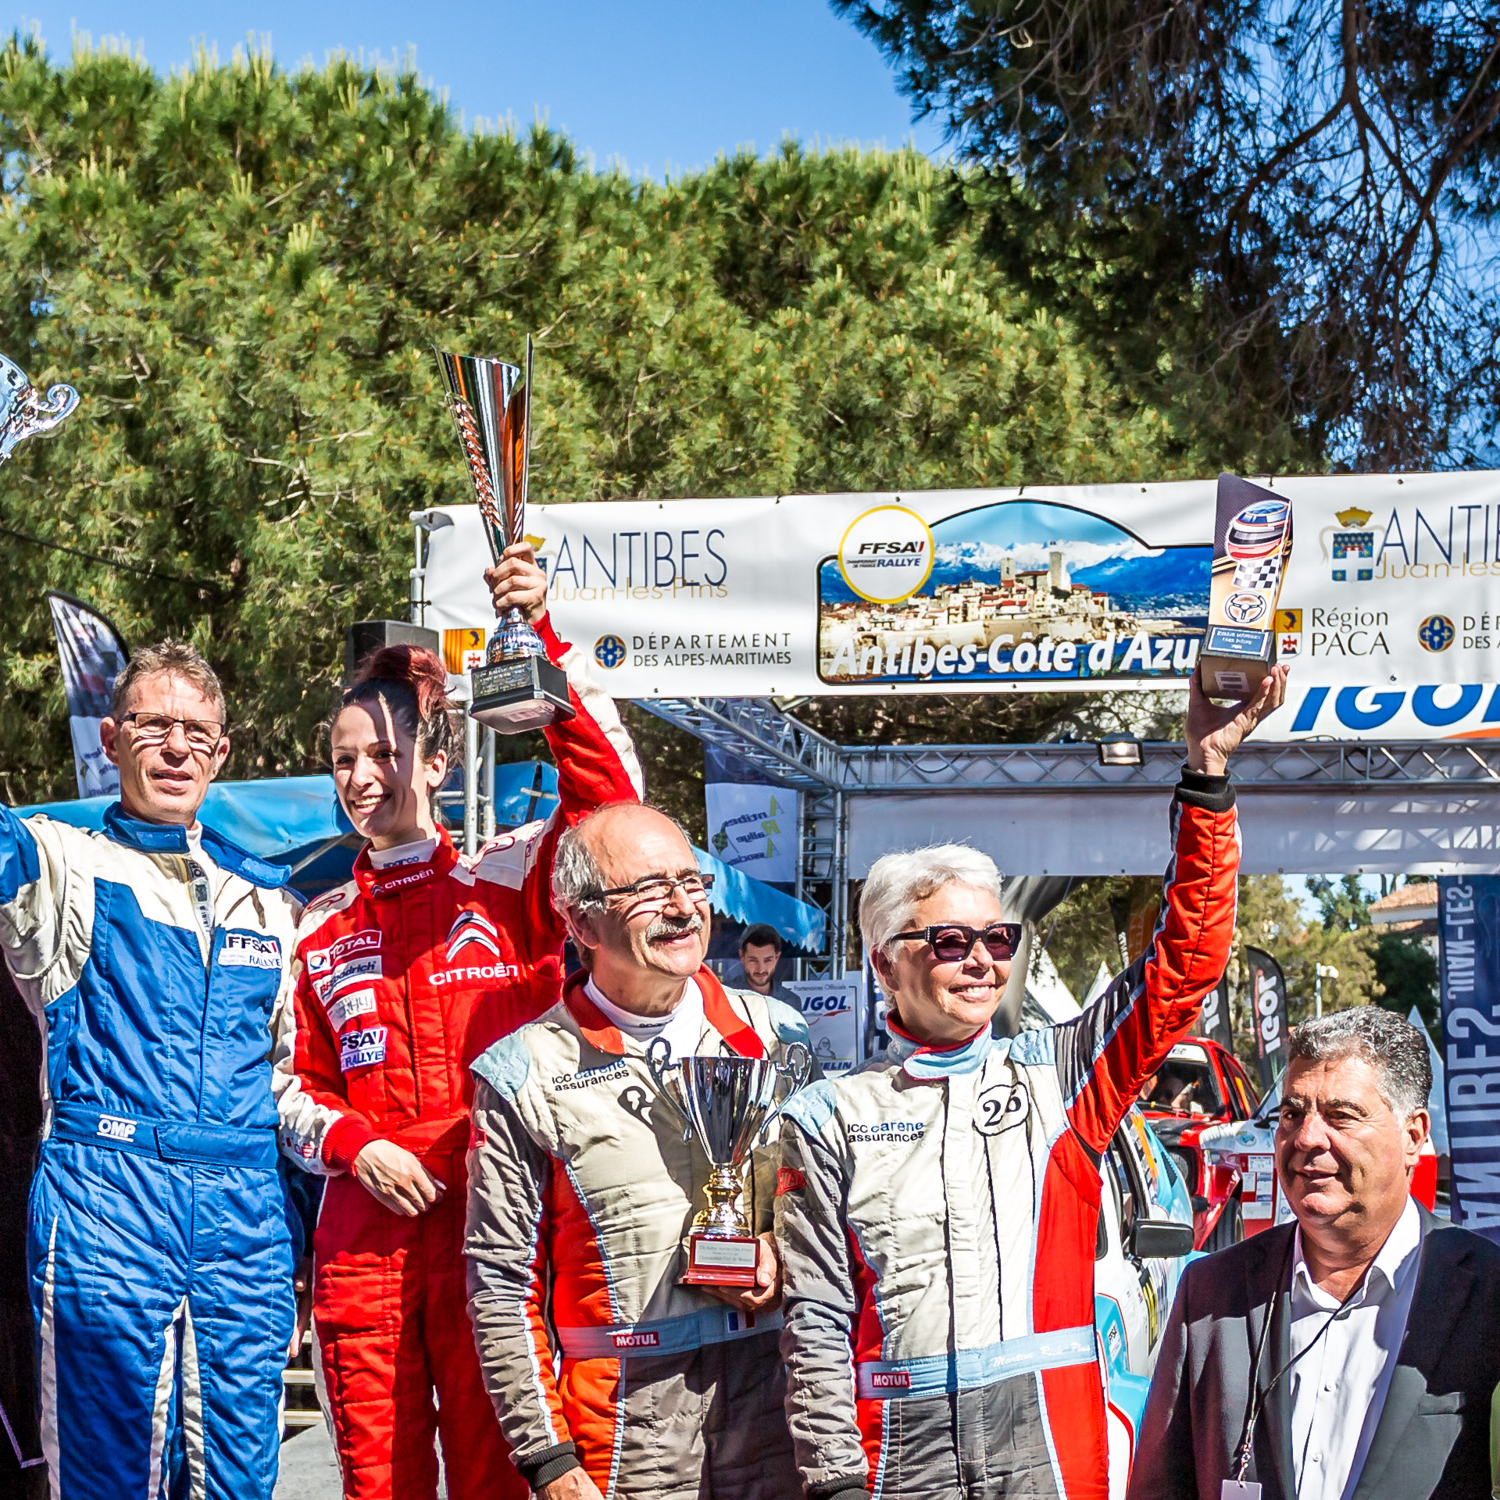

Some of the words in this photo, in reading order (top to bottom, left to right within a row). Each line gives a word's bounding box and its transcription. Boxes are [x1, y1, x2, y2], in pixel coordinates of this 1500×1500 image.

[858, 541, 917, 554] FFSA
[550, 528, 727, 589] ANTIBES
[877, 558, 921, 567] RALLYE
[549, 576, 728, 601] Juan-les-Pins
[1312, 607, 1389, 633] Région
[633, 631, 792, 650] DÉPARTEMENT
[1312, 631, 1390, 656] PACA
[1463, 635, 1490, 649] DES
[634, 654, 659, 667] DES
[664, 652, 792, 667] ALPES-MARITIMES
[829, 631, 1078, 676] Antibes-Côte
[1087, 631, 1200, 672] d'Azu
[228, 936, 272, 954] FFSA
[330, 935, 378, 960] TOTAL
[249, 955, 281, 967] RALLYE
[341, 1031, 377, 1050] FSA
[345, 1051, 384, 1067] RALLYE
[555, 1068, 629, 1092] assurances
[98, 1118, 136, 1139] OMP
[847, 1123, 869, 1134] ICC
[871, 1120, 924, 1133] carene
[849, 1131, 924, 1144] assurances
[614, 1332, 658, 1348] MOTUL
[874, 1373, 908, 1387] MOTUL
